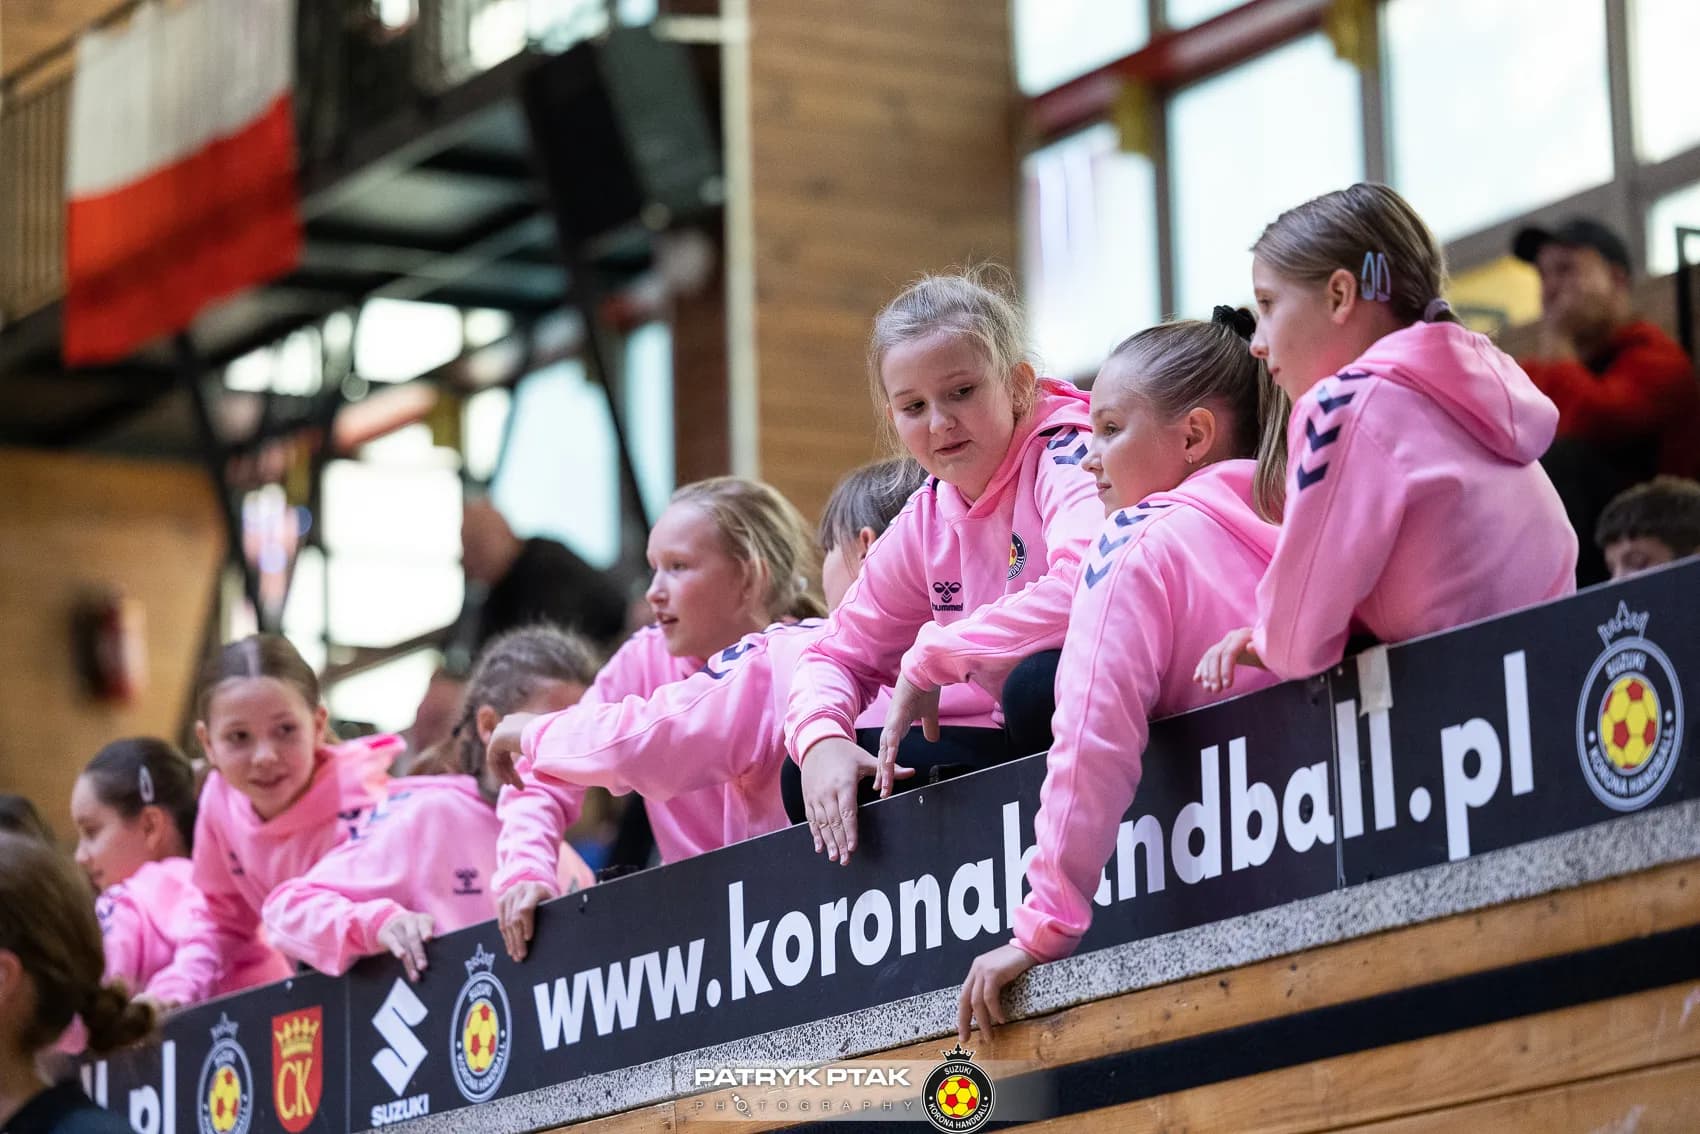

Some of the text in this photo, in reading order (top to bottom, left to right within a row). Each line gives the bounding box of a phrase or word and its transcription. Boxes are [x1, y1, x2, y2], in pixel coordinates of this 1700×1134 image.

[931, 601, 963, 611] hummel
[533, 650, 1534, 1050] www.koronahndball.pl
[277, 1057, 313, 1120] CK
[371, 1094, 429, 1127] SUZUKI
